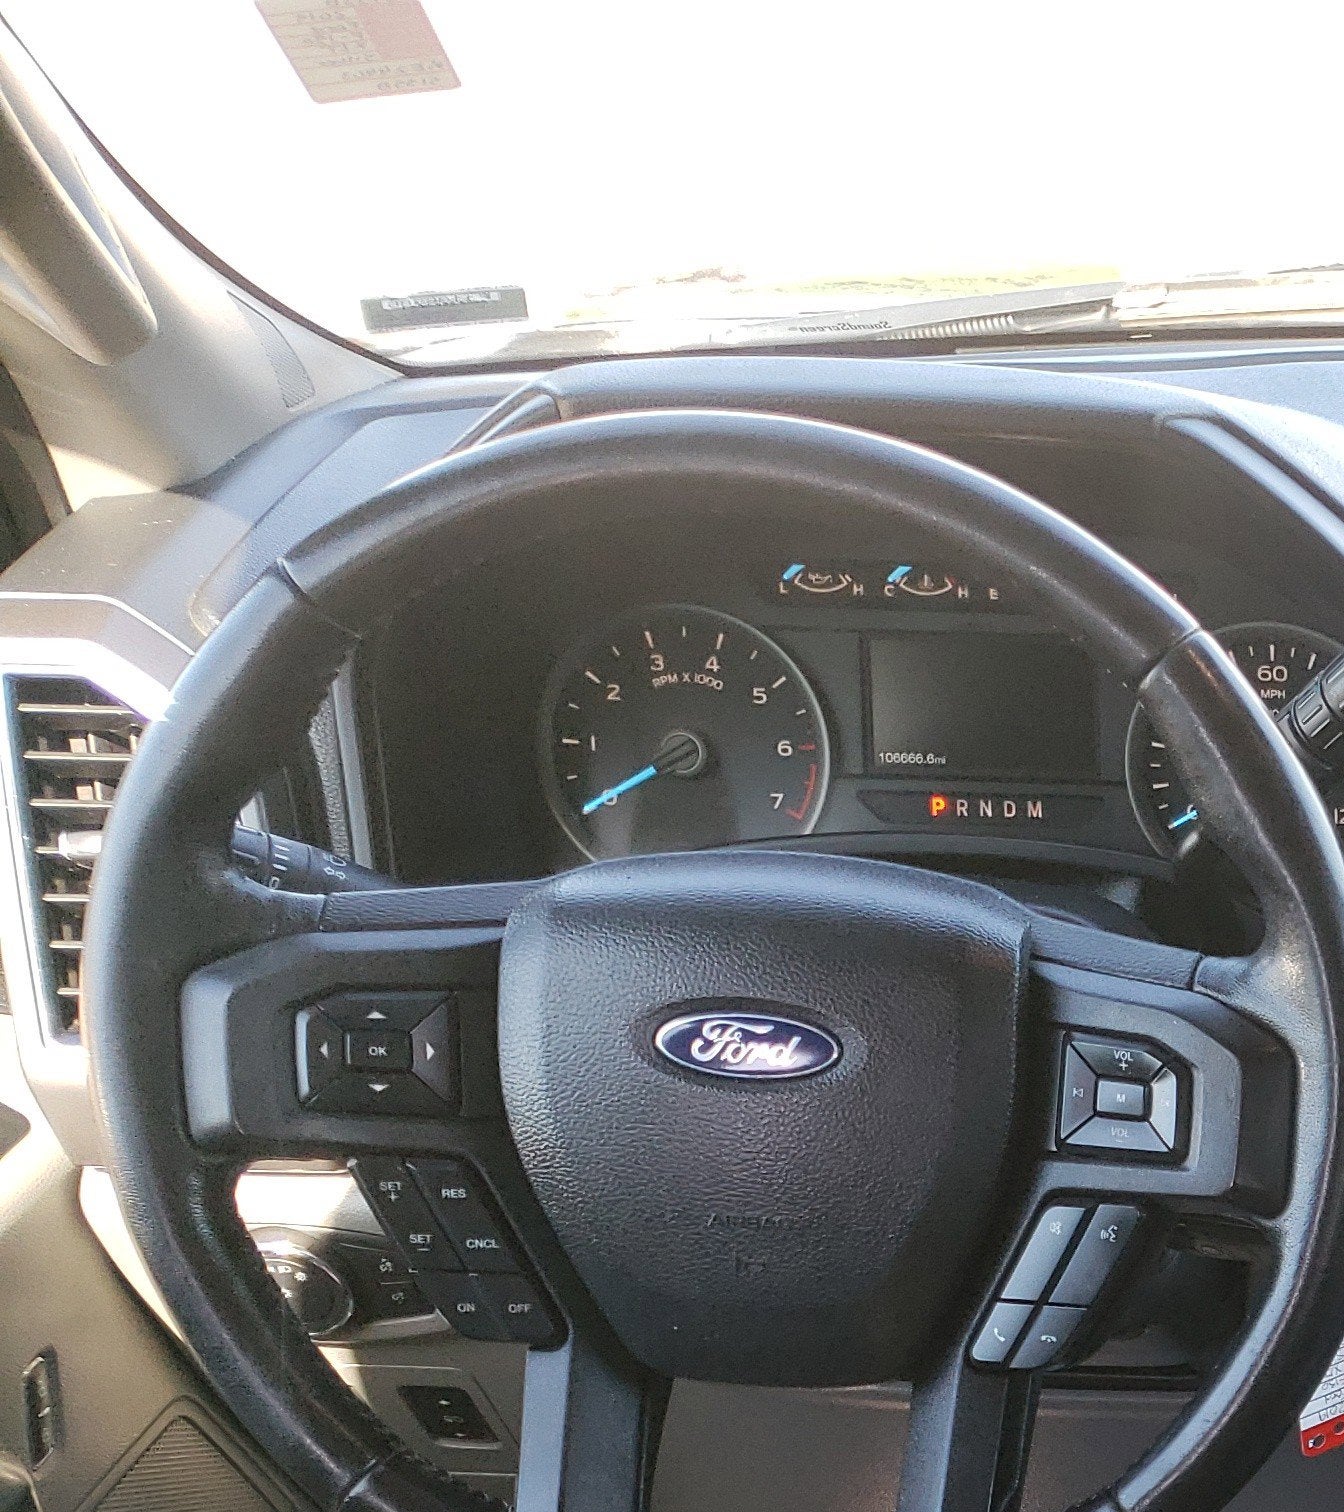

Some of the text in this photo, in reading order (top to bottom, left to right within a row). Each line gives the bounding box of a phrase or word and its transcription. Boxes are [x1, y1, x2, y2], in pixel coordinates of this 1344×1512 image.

[650, 654, 664, 671] 3
[705, 655, 721, 672] 4
[652, 672, 678, 688] RPM
[694, 672, 724, 690] 1000
[1256, 665, 1288, 683] 60
[606, 684, 621, 701] 2
[752, 687, 768, 704] 5
[1260, 688, 1287, 701] MPH
[590, 735, 597, 752] 1
[776, 740, 793, 757] 6
[769, 794, 784, 810] 7
[931, 795, 1042, 818] P R N D M
[367, 1045, 388, 1058] OK
[690, 1020, 802, 1067] Ford
[1113, 1050, 1134, 1061] VOL
[1110, 1126, 1130, 1138] VOL
[379, 1181, 402, 1192] SET
[441, 1188, 467, 1200] RES
[409, 1233, 433, 1245] SET
[465, 1238, 500, 1250] CNCL
[456, 1302, 476, 1314] ON
[507, 1302, 531, 1314] OFF
